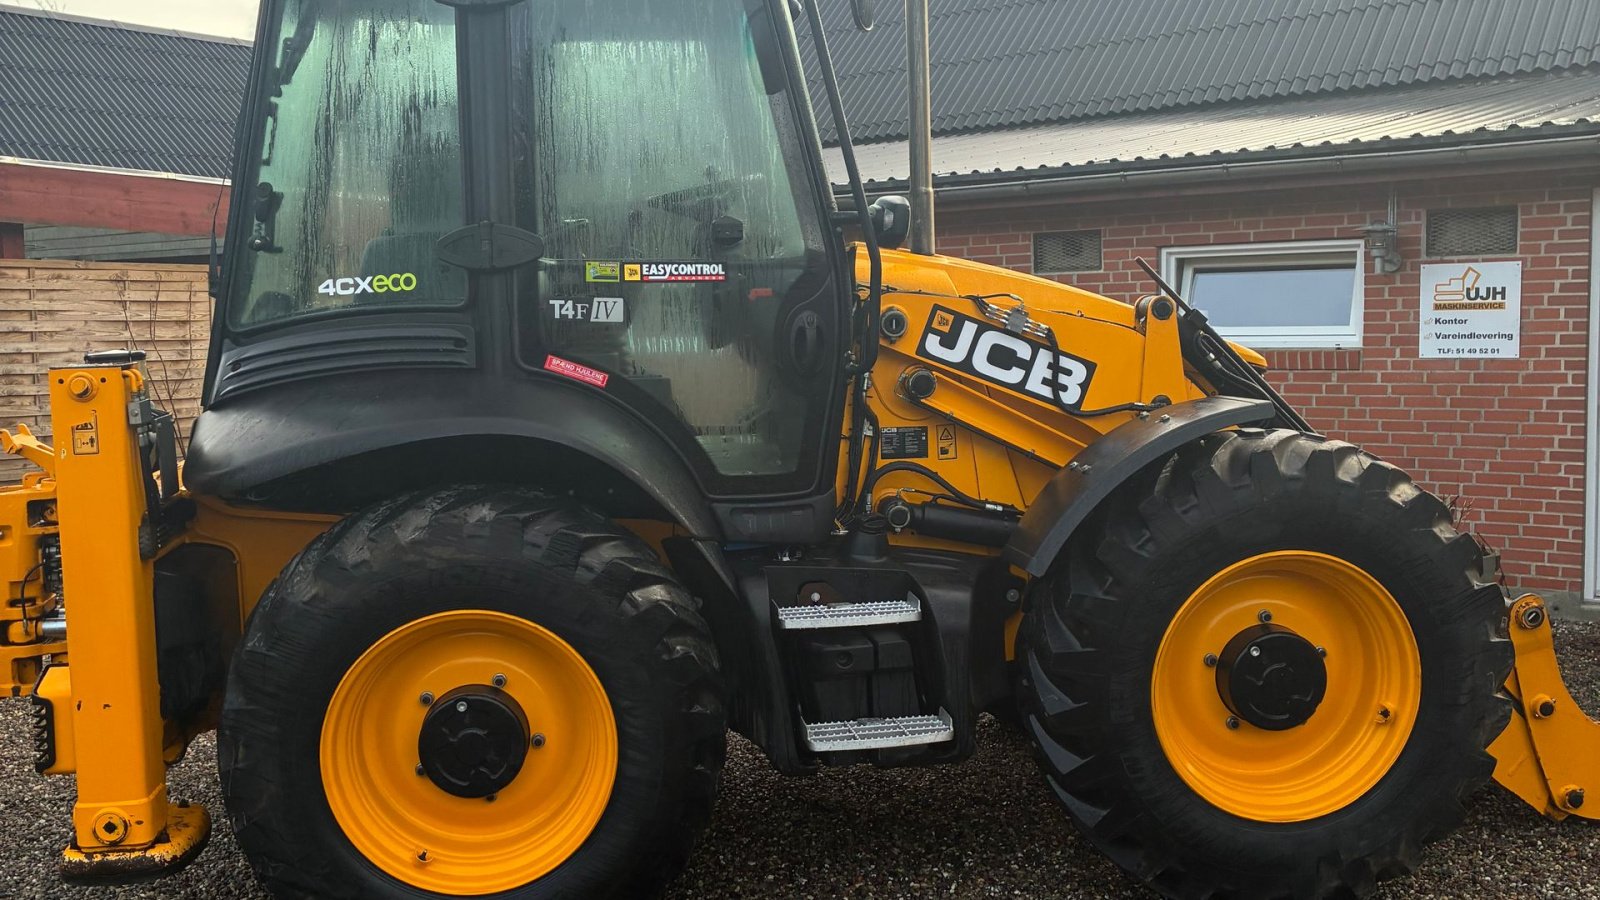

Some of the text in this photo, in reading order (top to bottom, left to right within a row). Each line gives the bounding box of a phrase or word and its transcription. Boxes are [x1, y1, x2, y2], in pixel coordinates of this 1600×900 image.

[642, 263, 725, 279] EASYCONTROL
[318, 273, 417, 296] 4CXeco
[1466, 286, 1506, 301] UJH
[549, 300, 618, 320] T4F IV
[1434, 302, 1505, 310] MASKINSERVICE
[1434, 317, 1468, 325] Kontor
[1434, 332, 1514, 341] Vareindlevering
[925, 320, 1087, 405] JCB
